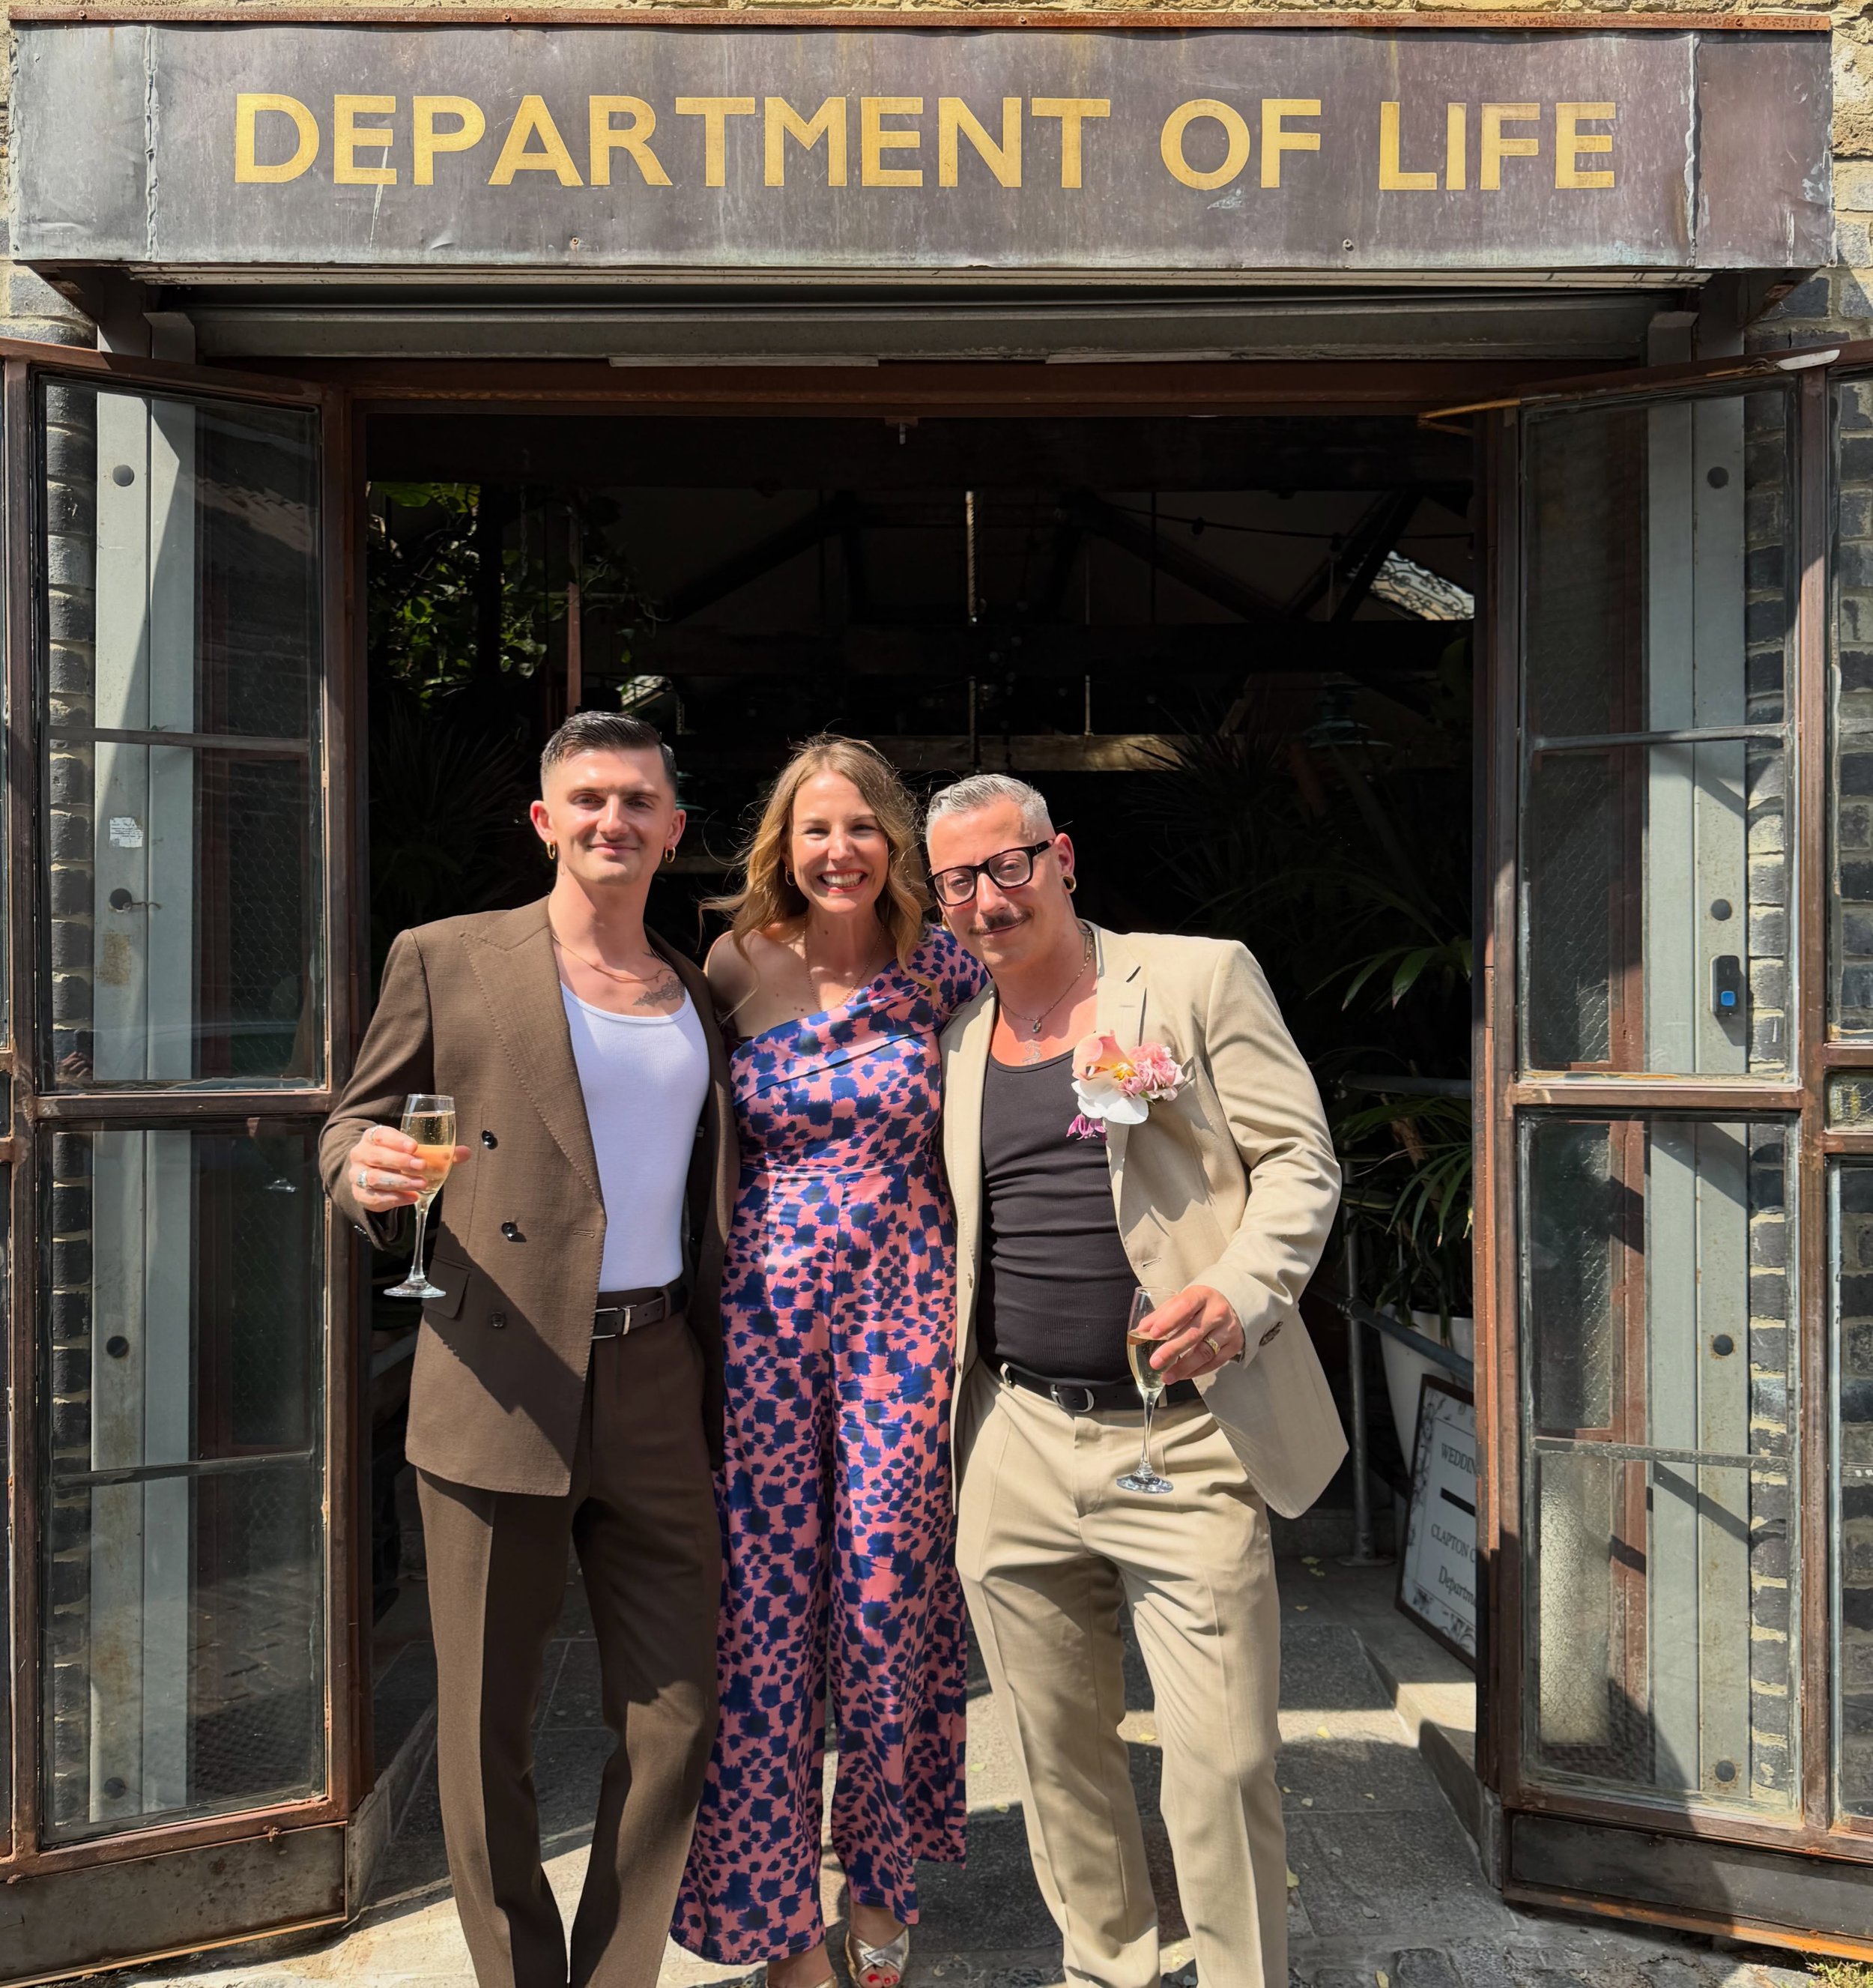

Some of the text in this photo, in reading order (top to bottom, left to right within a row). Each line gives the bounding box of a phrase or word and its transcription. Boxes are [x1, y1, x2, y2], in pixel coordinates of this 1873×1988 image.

[235, 94, 1615, 190] DEPARTMENT OF LIFE
[1441, 1442, 1476, 1475] WEDDIN
[1431, 1523, 1470, 1557] CLAPTON
